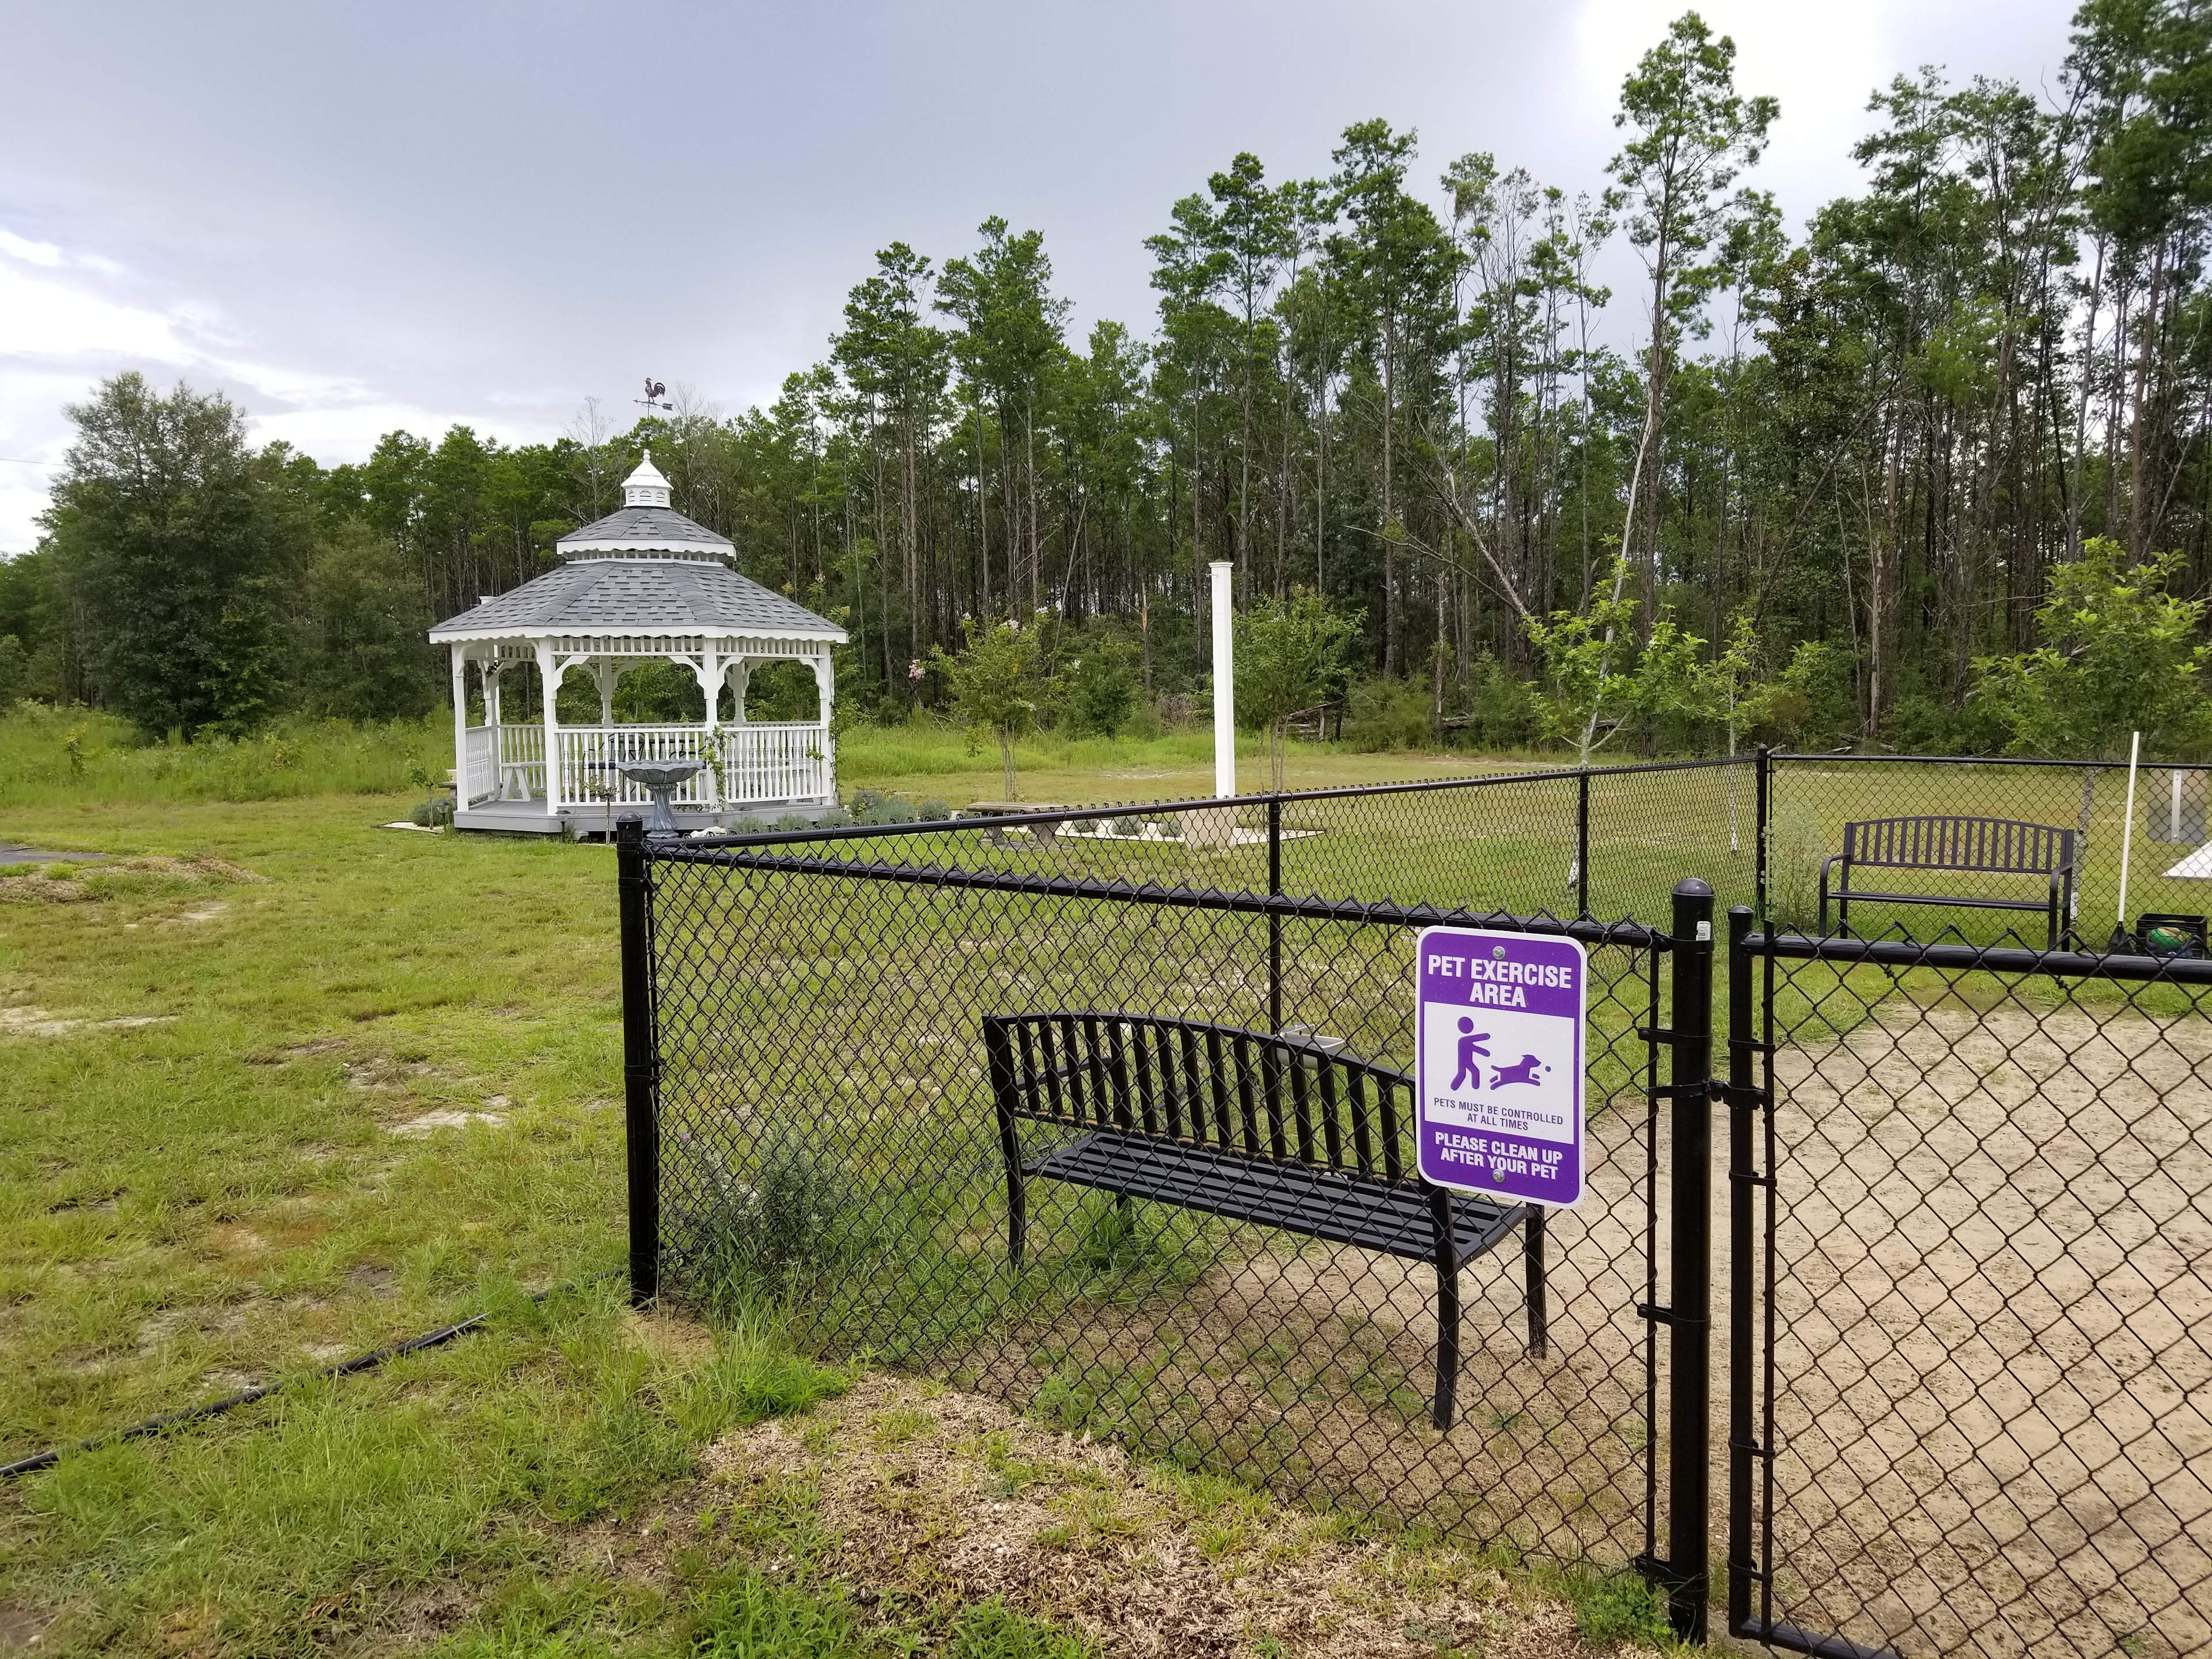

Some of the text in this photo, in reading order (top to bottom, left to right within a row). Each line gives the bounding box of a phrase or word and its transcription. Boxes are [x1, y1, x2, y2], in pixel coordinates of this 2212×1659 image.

[1428, 955, 1571, 988] PET EXERCISE
[1469, 983, 1527, 1008] AREA
[1434, 1097, 1563, 1124] PETS MUST BE CONTROLLED
[1467, 1113, 1528, 1130] AT ALL TIMES
[1435, 1132, 1562, 1164] PLEASE CLEAN UP
[1440, 1147, 1558, 1180] AFTER YOUR PET
